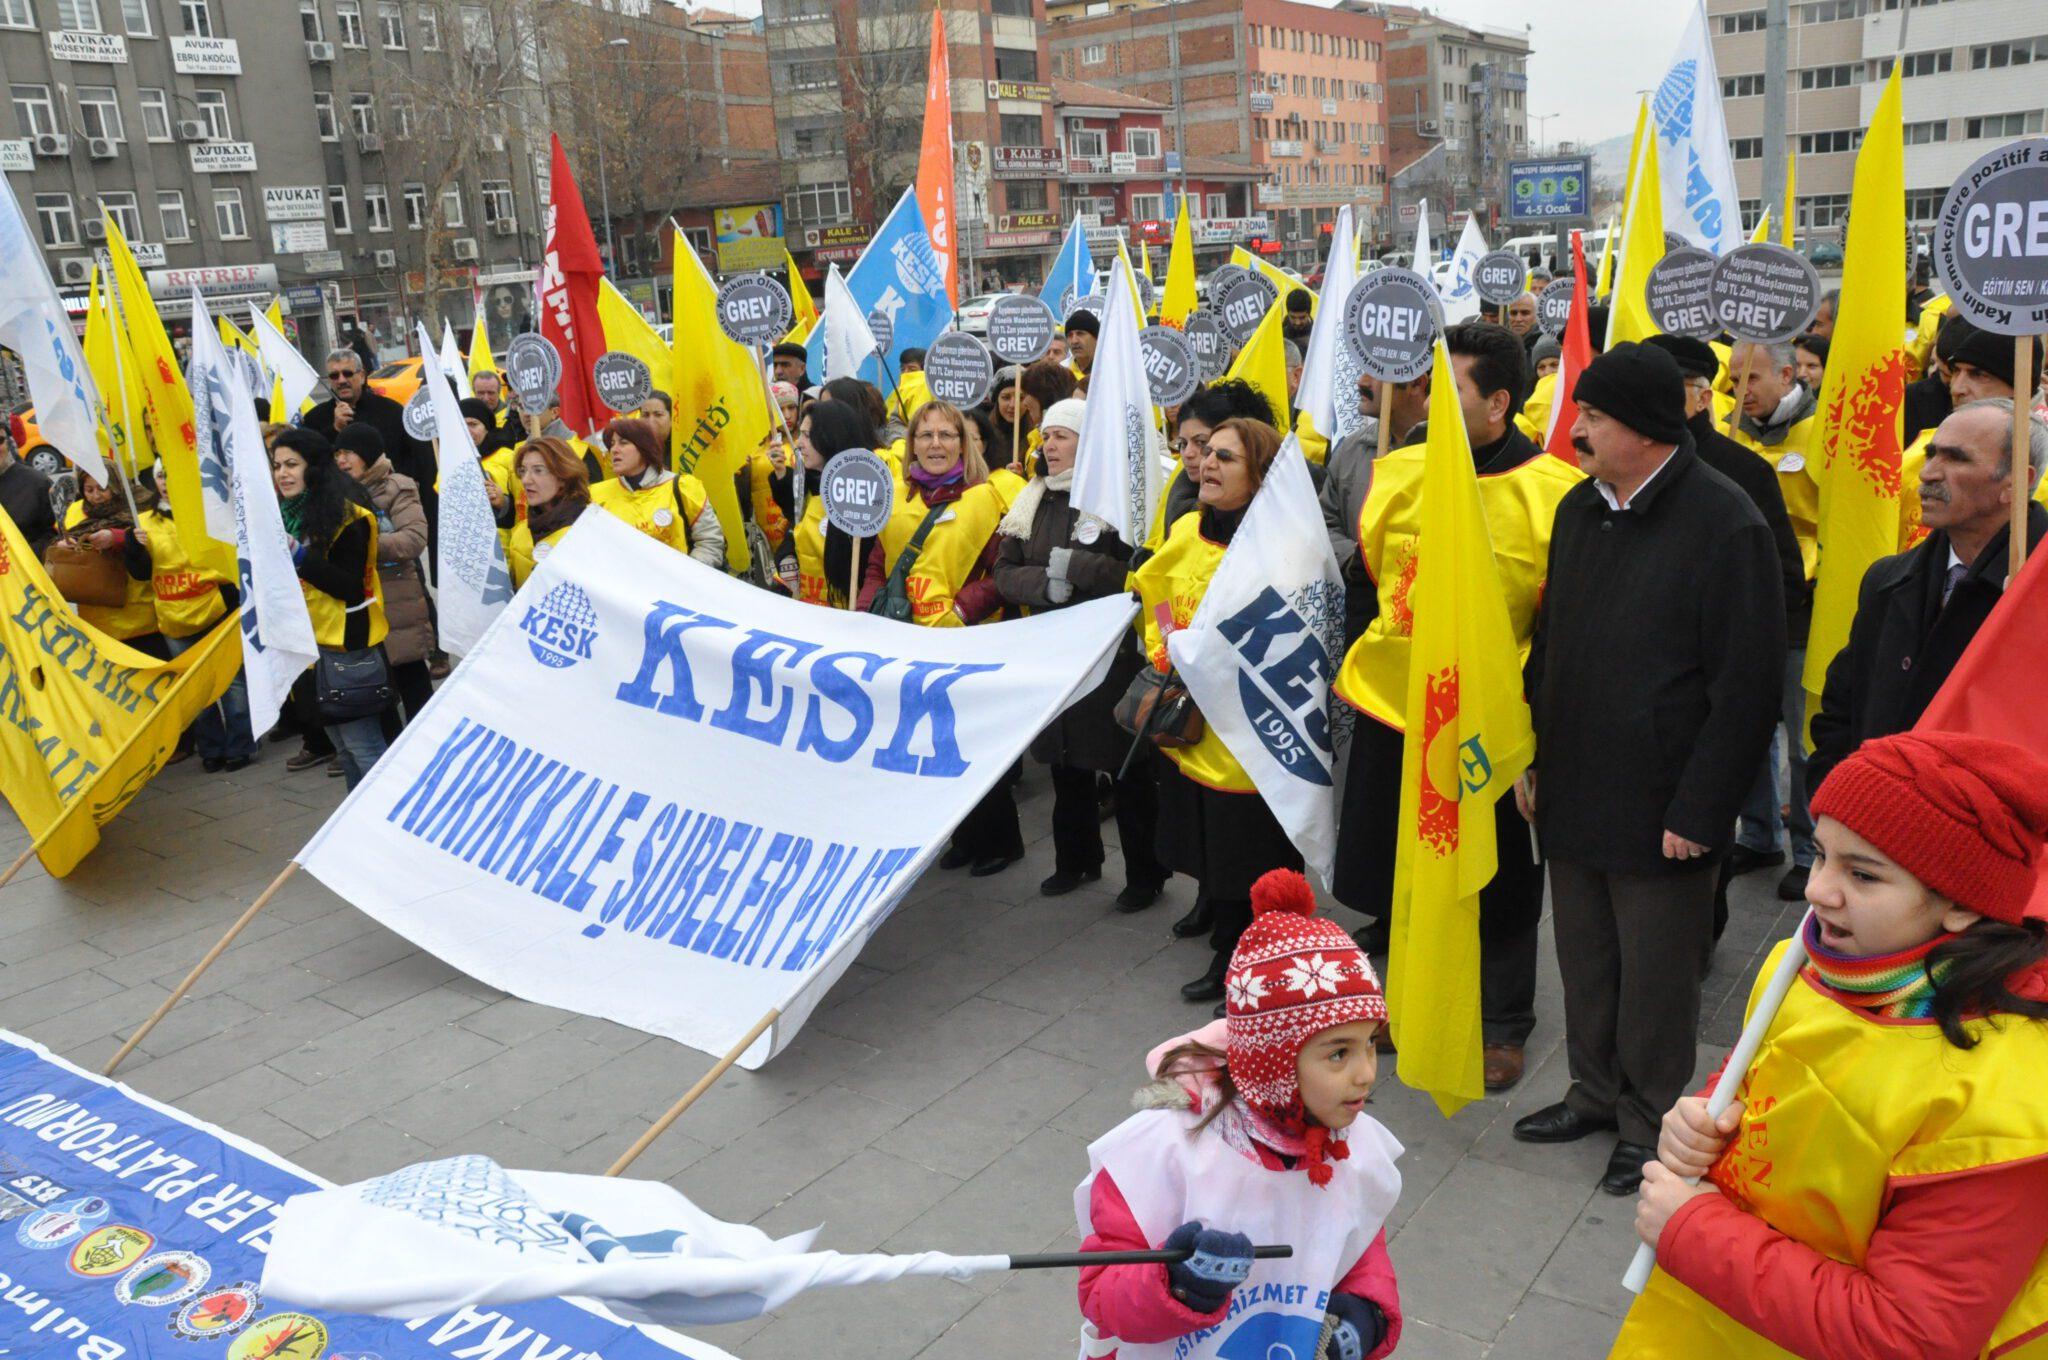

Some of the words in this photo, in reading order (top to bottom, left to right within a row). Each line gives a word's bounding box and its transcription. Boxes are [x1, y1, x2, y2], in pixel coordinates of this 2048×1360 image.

[61, 34, 114, 45] AVUKAT
[99, 47, 124, 55] AKAY
[184, 40, 224, 49] AVUKAT
[176, 53, 200, 62] EBRU
[1000, 83, 1017, 97] KALE
[196, 145, 249, 155] AVUKAT
[1011, 149, 1041, 158] KALE
[1971, 147, 2031, 190] pozitif
[267, 188, 321, 201] AVUKAT
[1544, 182, 1551, 193] T
[1567, 181, 1575, 192] S
[1018, 215, 1043, 225] KALE
[1525, 205, 1542, 215] 4-5
[1545, 203, 1571, 214] Ocak
[827, 228, 852, 237] KALE
[1941, 184, 1970, 292] emekçilere
[1964, 200, 2048, 259] GRE
[101, 245, 157, 257] AKAT
[166, 267, 259, 286] REFREF
[1482, 266, 1517, 285] GREV
[1722, 268, 1752, 283] Yönelik
[1754, 274, 1809, 294] Maaşlarımıza
[1982, 276, 2013, 296] EĞİTİM
[2014, 280, 2034, 296] SEN
[716, 277, 753, 309] Mahkum
[1213, 274, 1245, 317] Mahkum
[1715, 280, 1728, 294] 300
[1729, 283, 1738, 296] TL
[1740, 285, 1756, 299] Zam
[1756, 291, 1790, 306] yapılması
[726, 295, 772, 323] GREV
[1225, 290, 1267, 328] GREV
[1720, 299, 1787, 331] GREV
[1963, 292, 2012, 325] Kadın
[1361, 302, 1422, 343] GREV
[996, 336, 1038, 352] GREV
[1189, 331, 1217, 354] GREV
[1141, 342, 1183, 384] GREV
[519, 366, 543, 391] GREV
[601, 369, 636, 391] GREV
[934, 379, 976, 399] GREV
[412, 400, 434, 423] GRE
[832, 477, 878, 507] GREV
[905, 576, 932, 599] EV
[519, 605, 599, 659] KESK
[540, 649, 564, 667] 1995
[615, 600, 1006, 778] KESK
[1252, 706, 1307, 766] 1995
[386, 716, 651, 913] KIRIKKALE
[581, 802, 800, 966] ŞUBELER
[0, 1093, 218, 1202] PLATFORMU
[10, 1175, 68, 1203] BTS
[1226, 1282, 1308, 1321] HİZMET
[0, 1271, 127, 1360] Bulm
